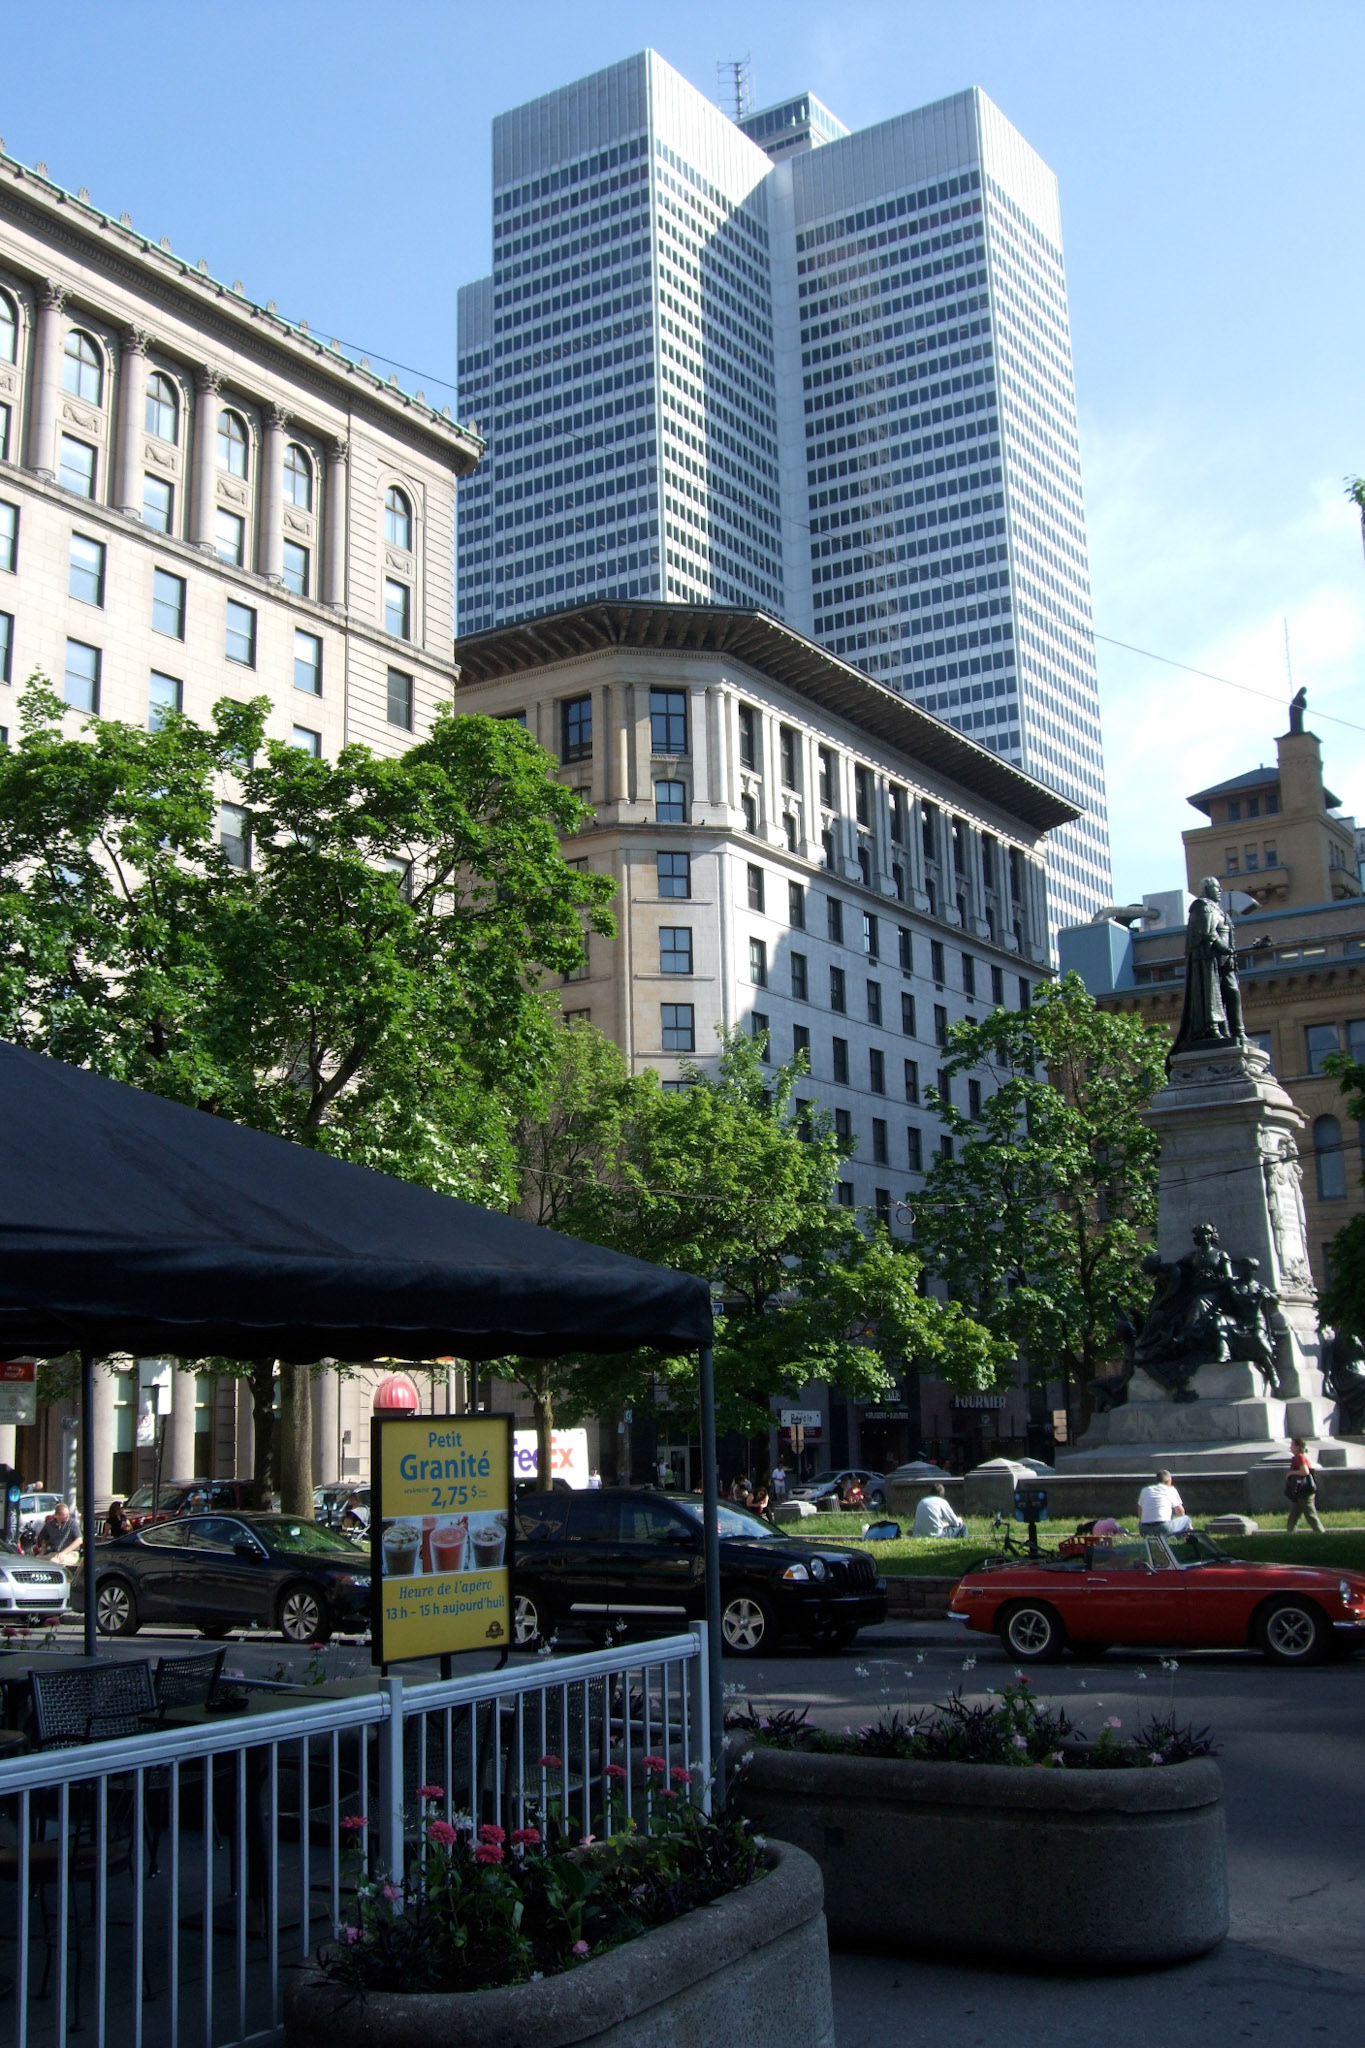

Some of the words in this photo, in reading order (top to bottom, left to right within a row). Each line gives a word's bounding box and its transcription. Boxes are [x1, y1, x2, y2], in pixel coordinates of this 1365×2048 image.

[955, 1394, 1007, 1409] FOURNIER
[428, 1430, 462, 1448] Petit
[400, 1450, 490, 1481] Granité
[431, 1485, 468, 1509] 2,75
[471, 1484, 478, 1499] $
[399, 1585, 434, 1600] Heure
[437, 1582, 451, 1596] de
[454, 1578, 493, 1596] l'apéro
[386, 1607, 397, 1620] 13
[400, 1606, 408, 1619] h
[419, 1603, 430, 1617] 15
[433, 1602, 440, 1615] h
[442, 1595, 505, 1617] aujourd'hui!
